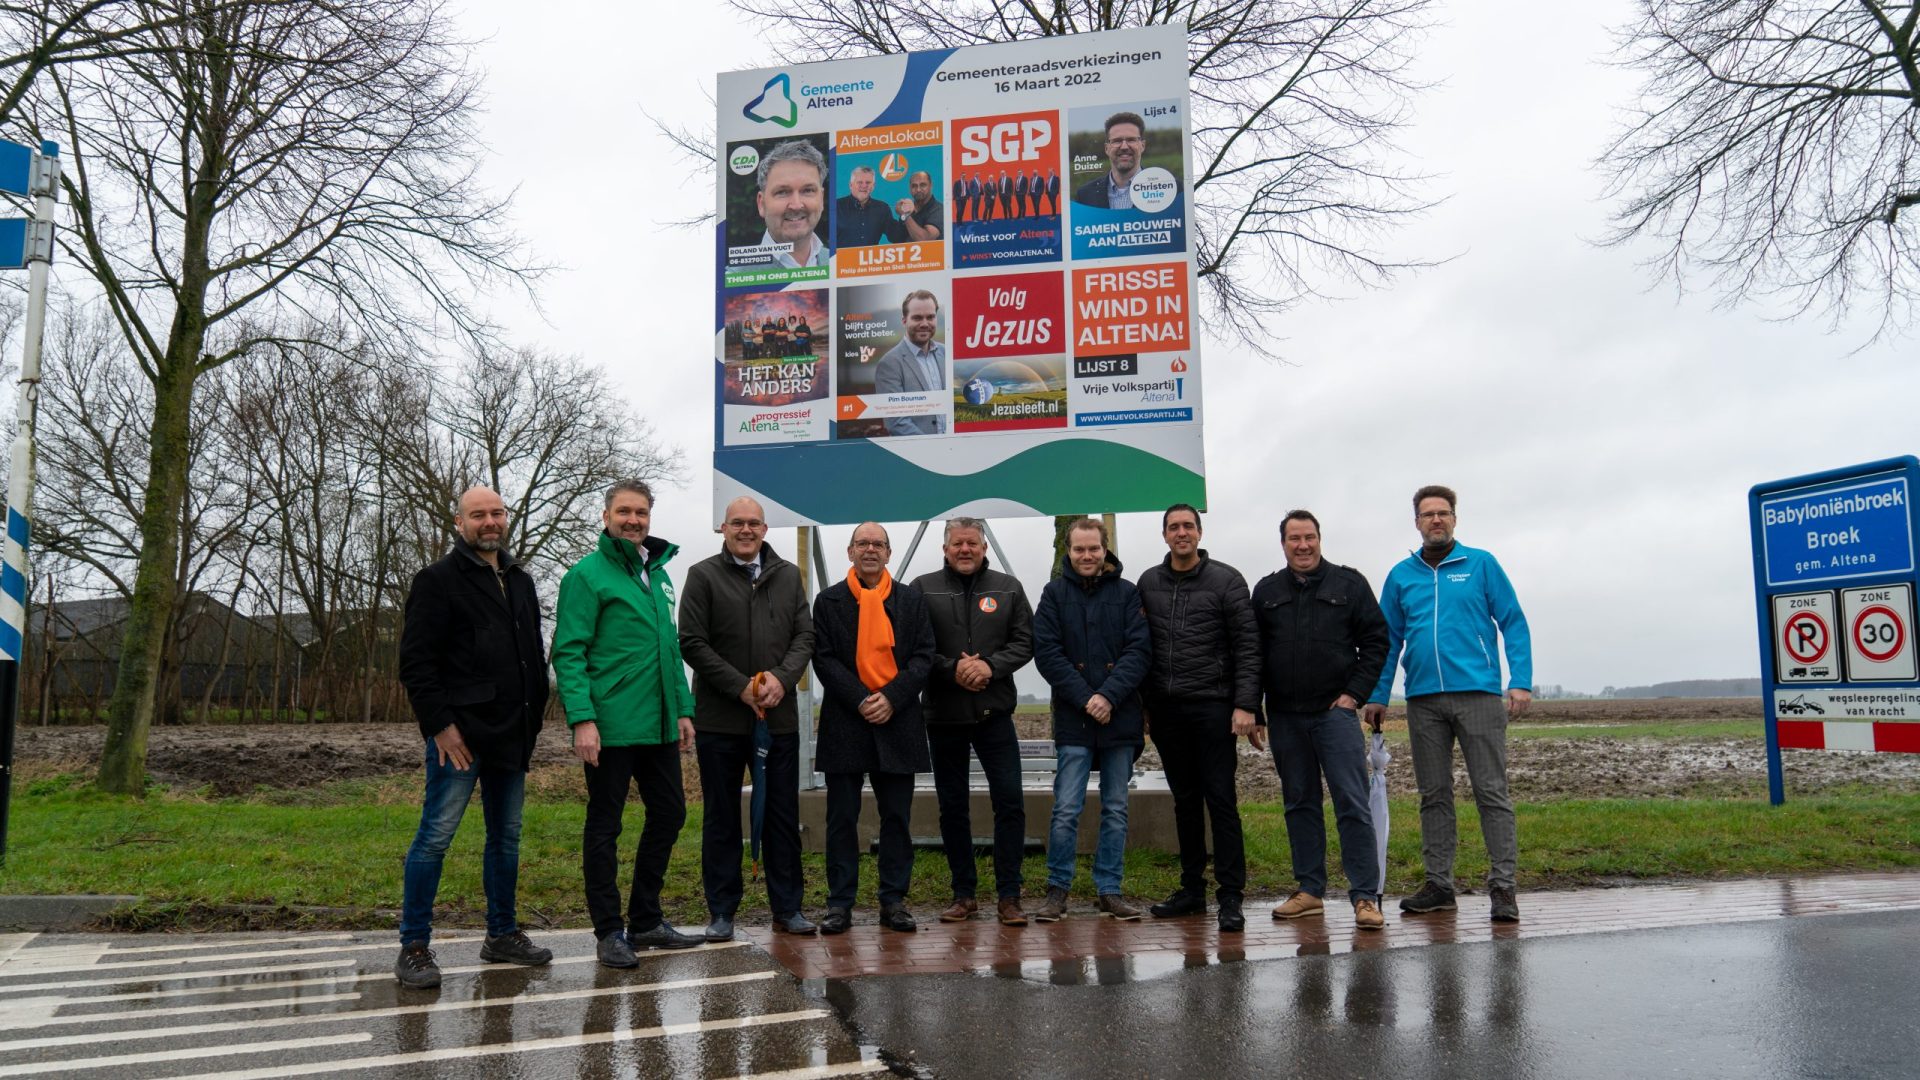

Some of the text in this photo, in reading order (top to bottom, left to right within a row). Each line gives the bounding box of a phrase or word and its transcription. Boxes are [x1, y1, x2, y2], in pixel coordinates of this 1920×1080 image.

[936, 50, 1161, 82] Gemeenteraadsverkiezingen
[801, 80, 874, 96] Gemeente
[995, 72, 1101, 93] 16 Maart 2022
[806, 96, 853, 109] Altena
[1144, 106, 1177, 118] Lijst 4
[840, 126, 940, 148] AltenaLokaal
[961, 120, 1052, 166] SGP
[732, 156, 756, 165] CDA
[1074, 154, 1098, 162] Anne
[1074, 162, 1102, 171] Duizer
[1133, 182, 1173, 191] Christen
[1142, 191, 1164, 199] Unie
[1075, 218, 1181, 236] SAMEN BOUWEN
[960, 229, 1054, 244] Winst voor Altena
[1088, 232, 1168, 248] AAN ALTENA
[859, 245, 921, 266] LIJST 2
[970, 248, 1054, 260] WINSTVOORALTENA.NL
[726, 275, 754, 283] THUIS
[791, 269, 827, 278] ALTENA
[1085, 268, 1175, 294] FRISSE
[989, 287, 1027, 310] Volg
[1078, 294, 1181, 320] WIND IN
[845, 321, 887, 331] blijft goed
[966, 315, 1052, 349] Jezus
[1078, 321, 1184, 346] ALTENA!
[845, 331, 869, 339] wordt
[738, 363, 815, 381] HET KAN
[1078, 360, 1129, 374] LIJST 8
[741, 379, 812, 397] ANDERS
[1083, 380, 1175, 395] Vrije Volkspartij
[1140, 392, 1175, 402] Altena
[844, 404, 853, 412] #1
[991, 400, 1058, 416] Jezusleeft.nl
[756, 409, 811, 423] progressief
[1080, 411, 1187, 423] WWW.VRIJEVOLKSPARTIJ.NL
[739, 420, 779, 433] Altena
[1766, 487, 1904, 525] Babyloniënbroek
[1807, 526, 1860, 549] Broek
[1795, 553, 1876, 574] gem. Altena
[1790, 598, 1817, 608] ZONE
[1861, 592, 1890, 602] ZONE
[1798, 623, 1816, 652] P
[1863, 623, 1895, 644] 30
[1828, 693, 1920, 705] wegsleepregeling
[1846, 706, 1905, 716] van kracht
